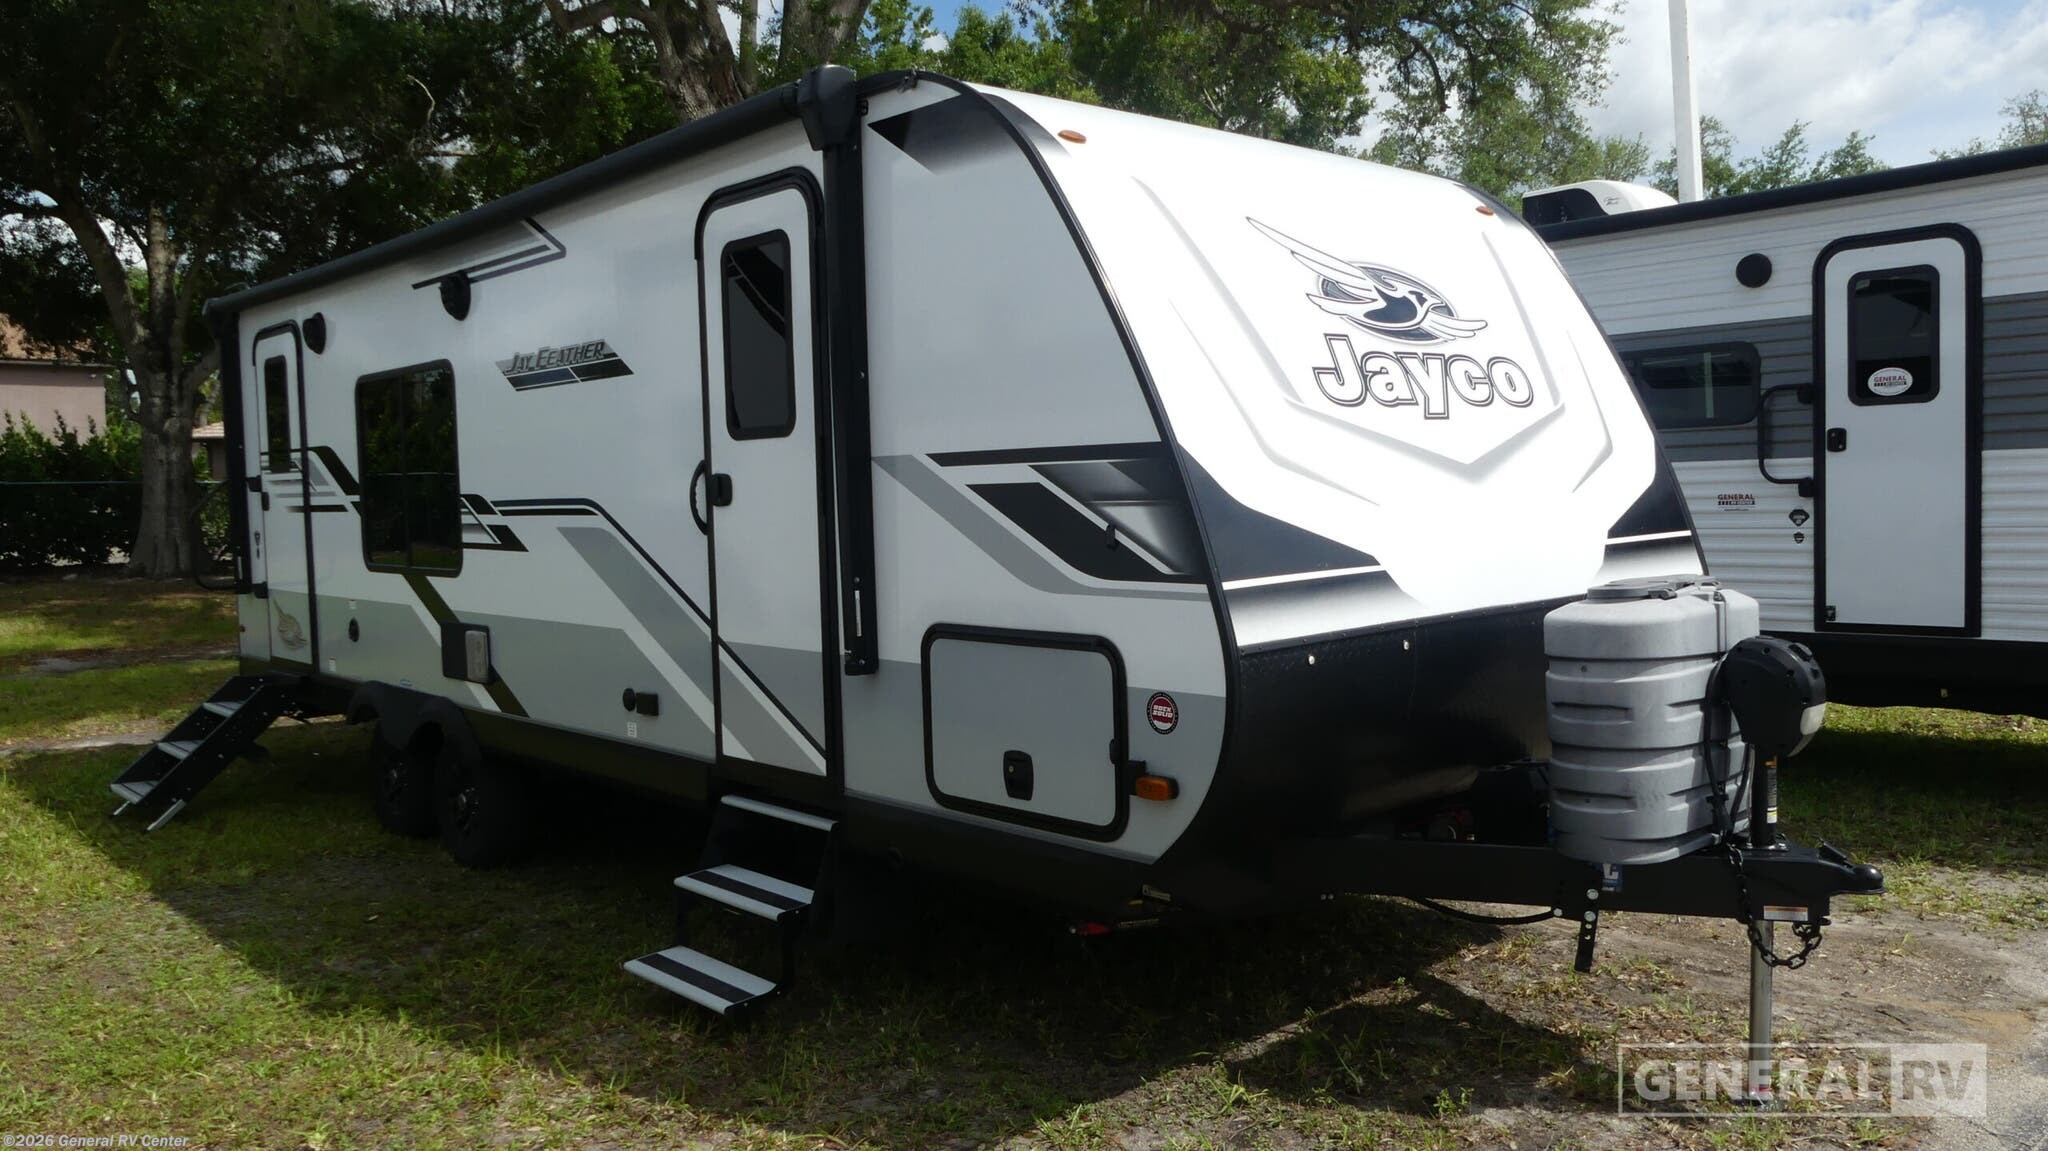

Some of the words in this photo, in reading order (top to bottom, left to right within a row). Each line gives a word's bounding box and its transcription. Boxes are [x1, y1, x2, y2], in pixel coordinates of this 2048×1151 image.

[504, 352, 533, 374] JAY
[535, 339, 606, 369] FEATHER
[1311, 333, 1534, 420] Jayco
[1874, 375, 1907, 383] GENERAL
[1152, 710, 1173, 719] SOLID
